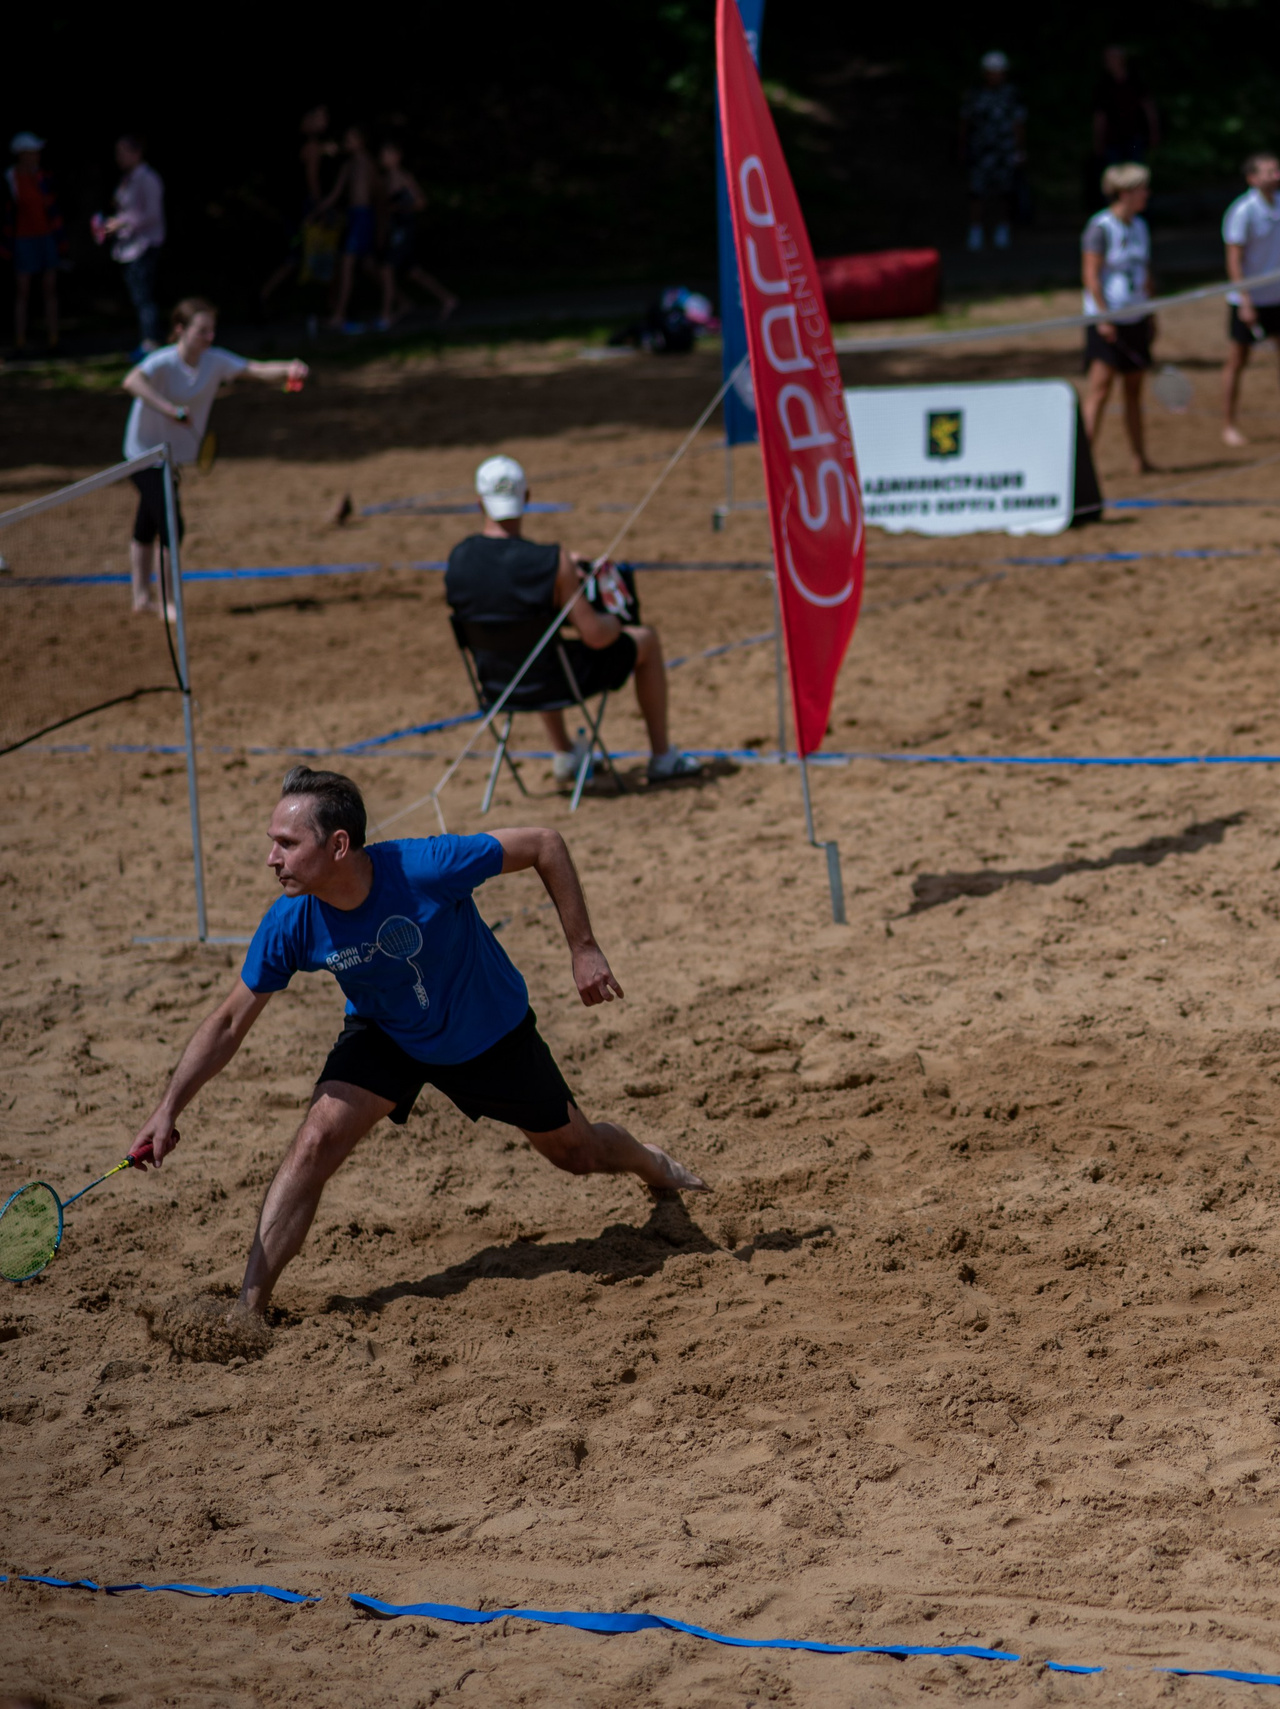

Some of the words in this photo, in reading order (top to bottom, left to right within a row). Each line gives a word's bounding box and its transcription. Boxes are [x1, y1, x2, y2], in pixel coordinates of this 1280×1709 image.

[774, 222, 826, 341] CENTER
[812, 345, 855, 461] RACKET
[326, 946, 359, 965] ВОЛАН
[329, 955, 363, 972] КЭМП
